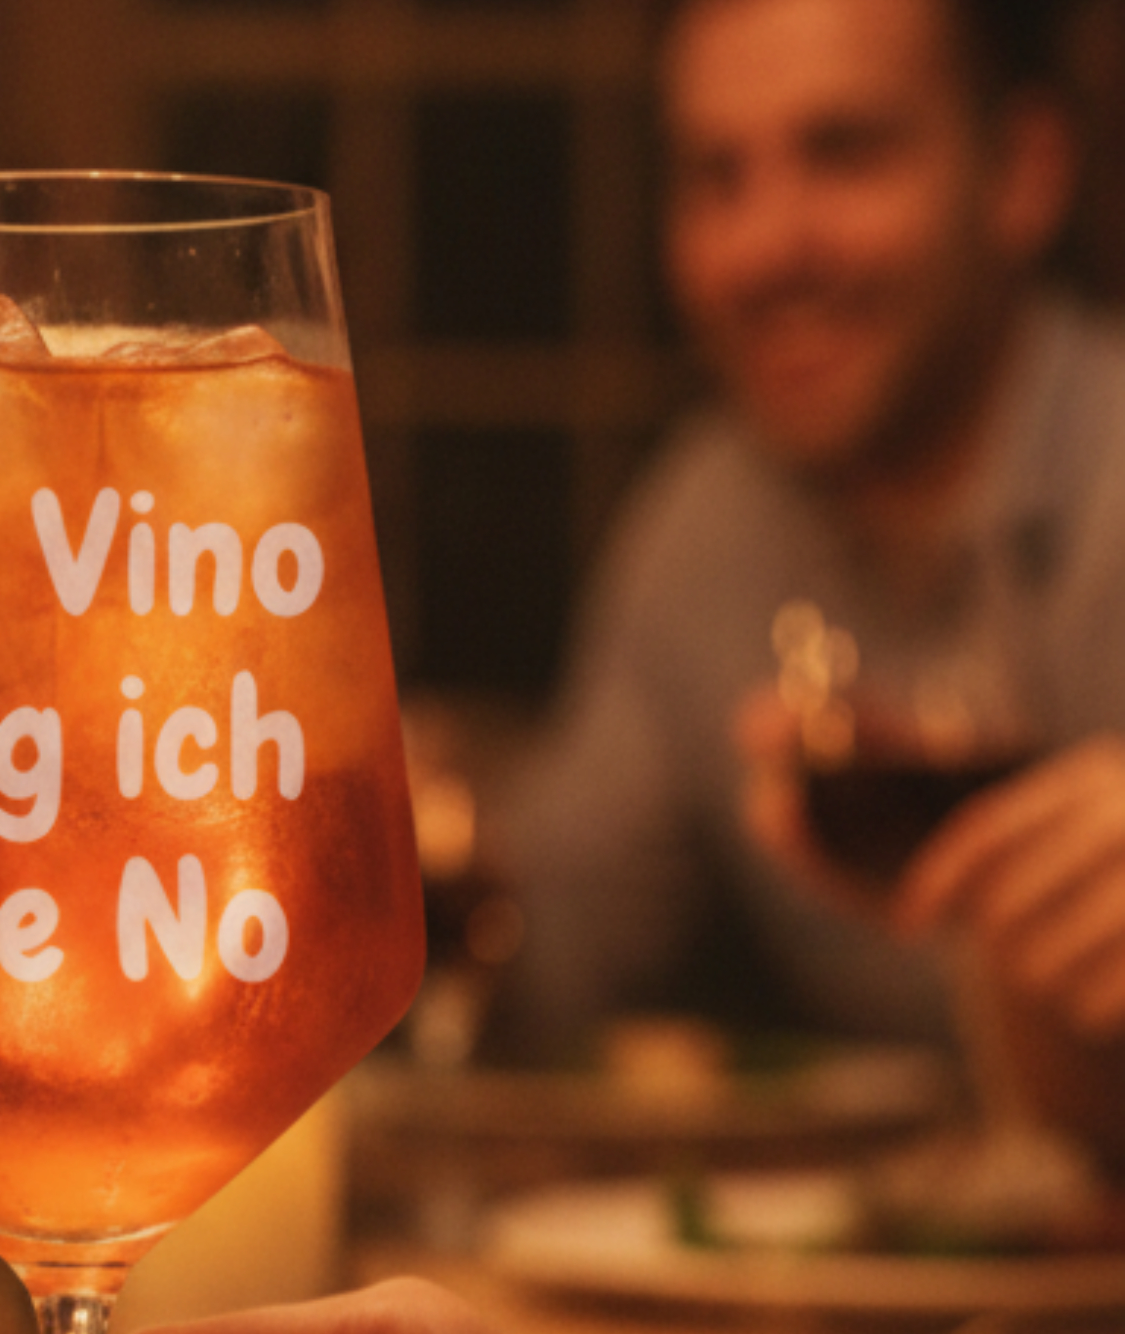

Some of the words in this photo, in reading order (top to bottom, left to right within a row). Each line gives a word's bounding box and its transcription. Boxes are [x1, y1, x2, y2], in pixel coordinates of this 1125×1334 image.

[31, 486, 324, 617] Vino
[117, 670, 305, 801] ich
[116, 854, 287, 983] No
